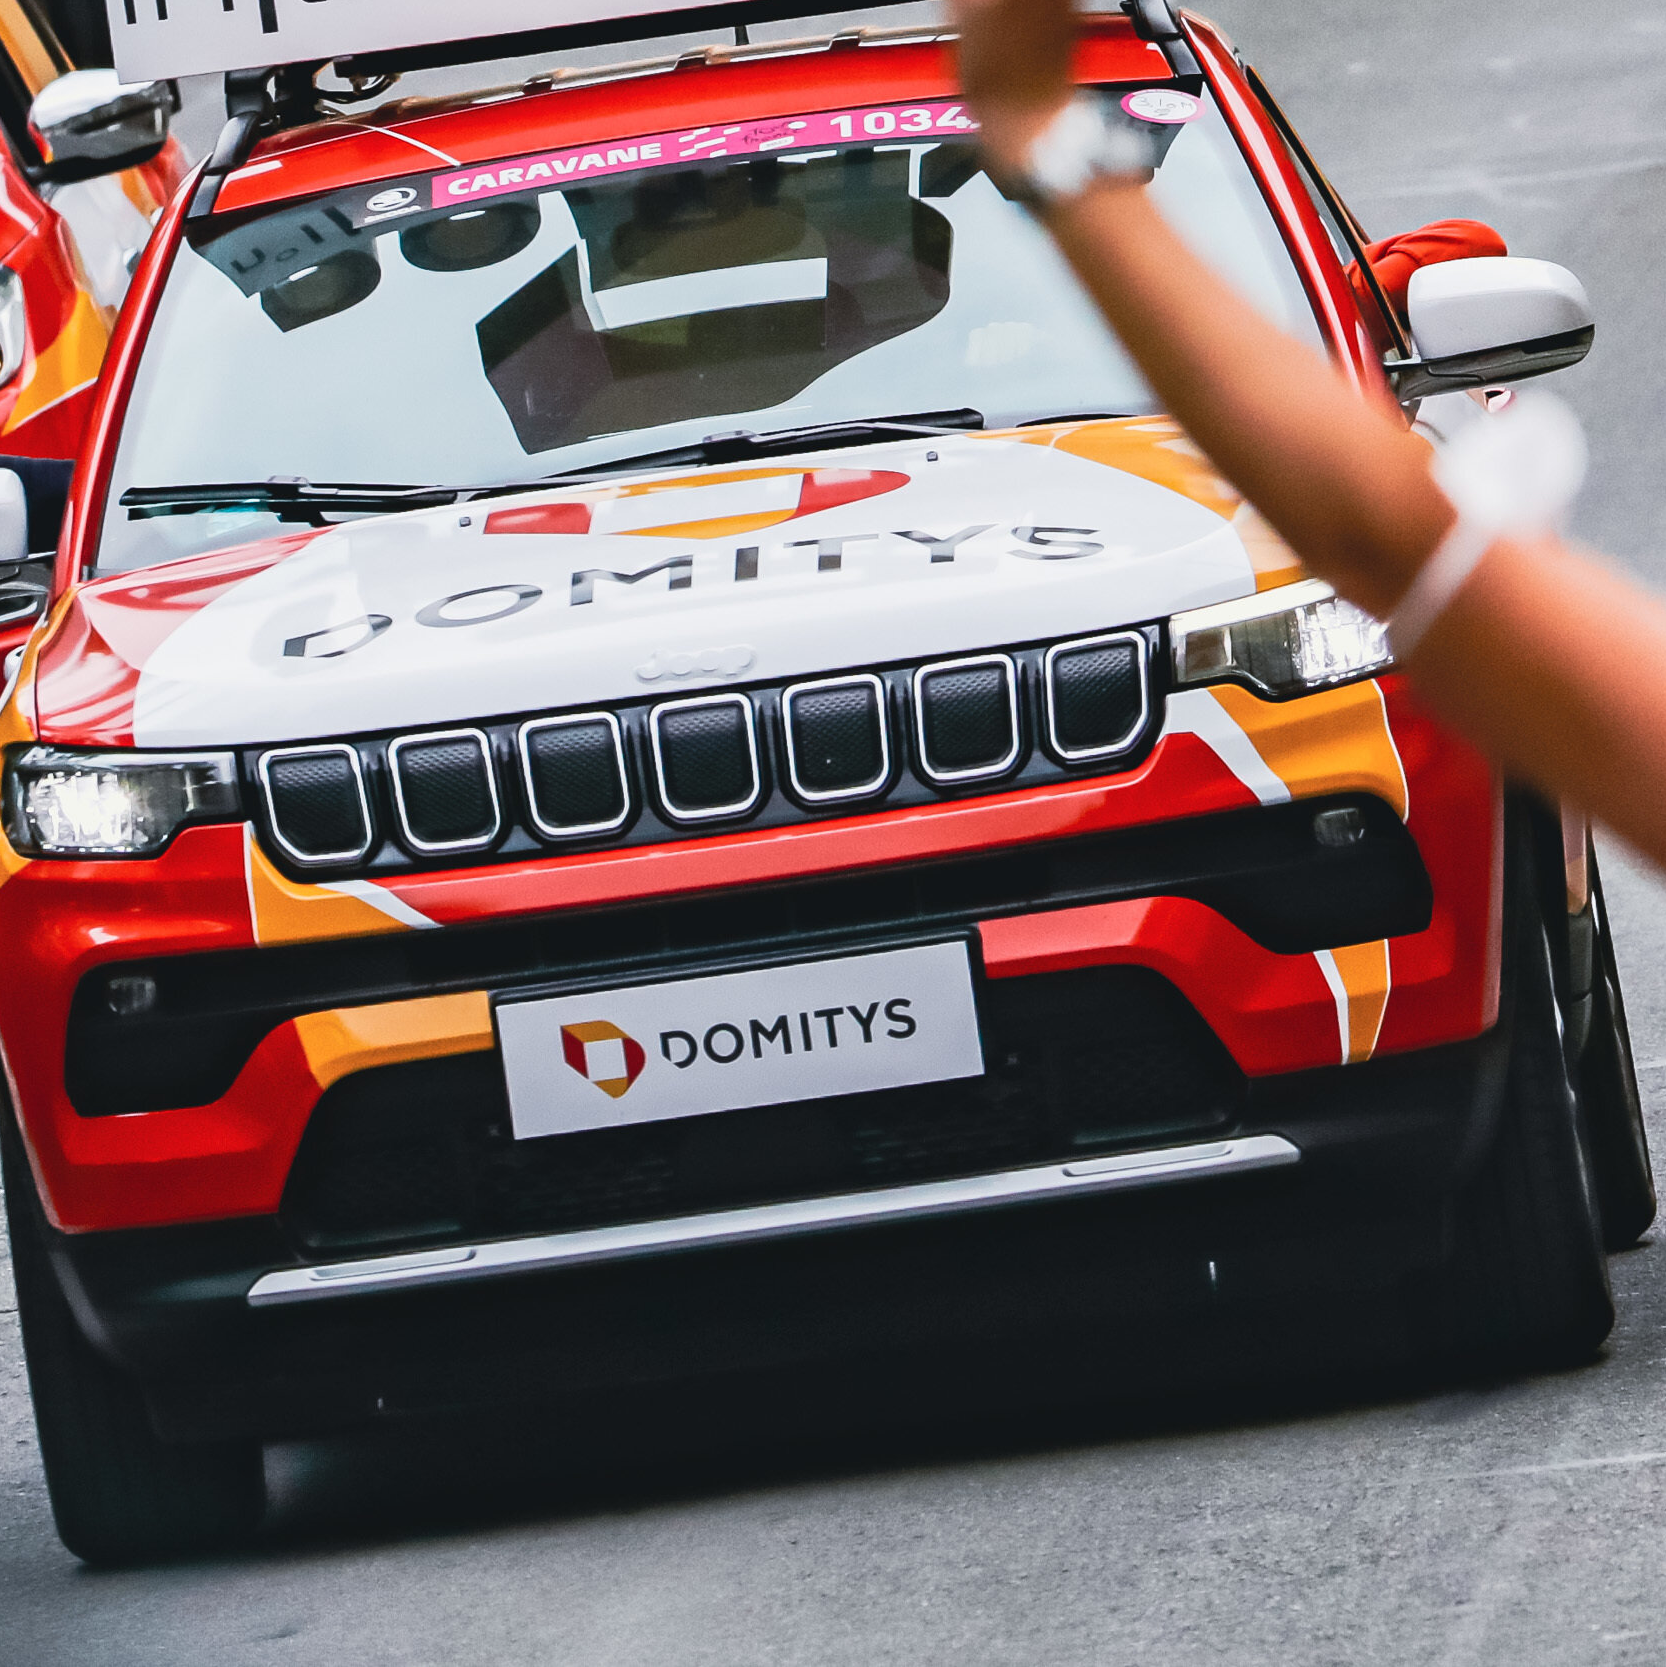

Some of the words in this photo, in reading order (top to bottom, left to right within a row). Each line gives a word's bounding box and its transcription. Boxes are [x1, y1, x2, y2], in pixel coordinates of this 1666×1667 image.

[447, 142, 662, 196] CARAVANE
[282, 524, 1106, 658] DOMITYS
[659, 997, 917, 1069] DOMITYS
